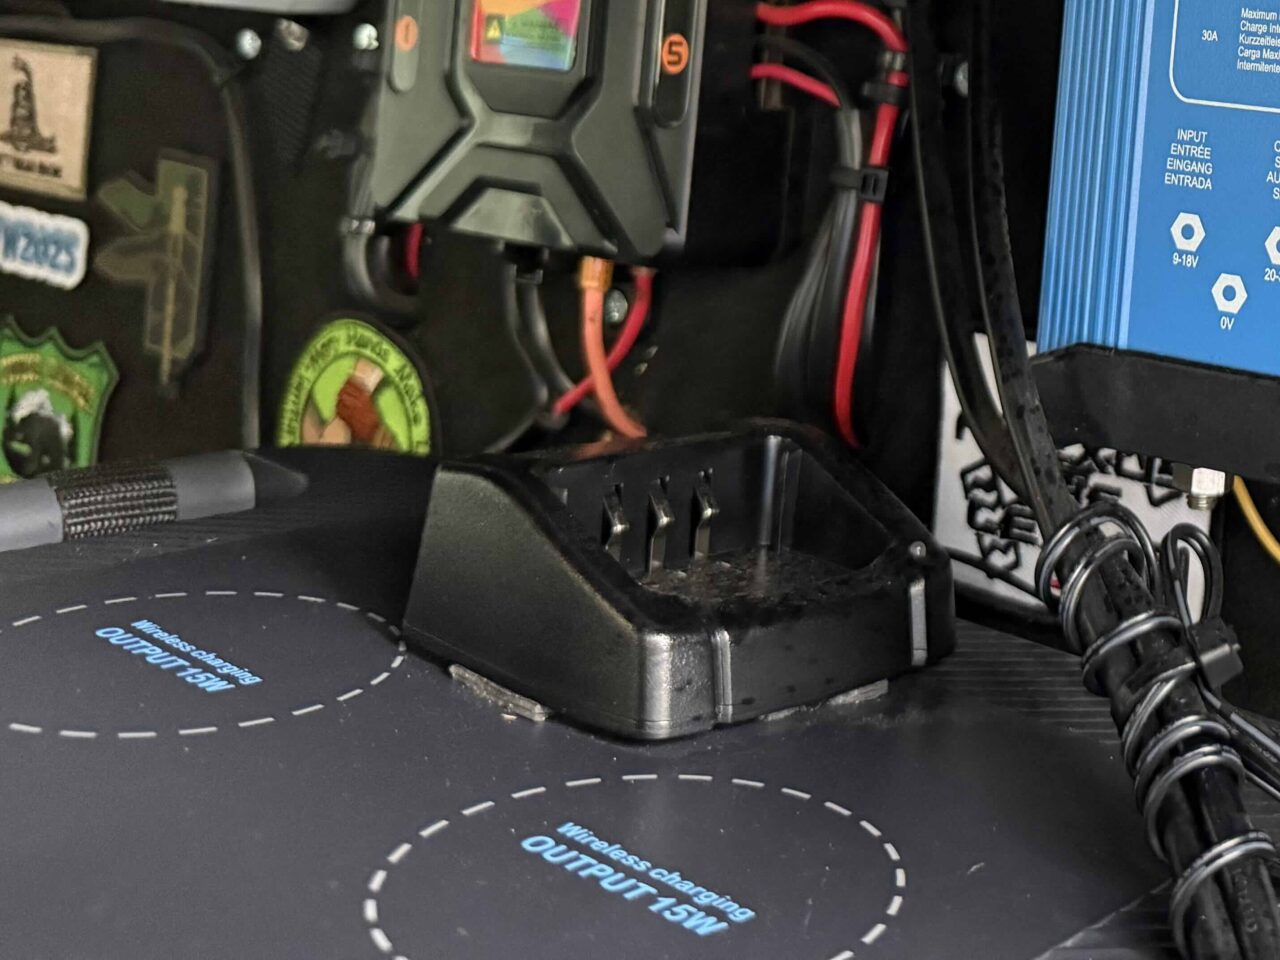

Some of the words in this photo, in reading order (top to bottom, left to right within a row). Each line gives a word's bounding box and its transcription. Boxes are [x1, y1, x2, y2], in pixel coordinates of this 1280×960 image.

[1240, 7, 1278, 20] Maximum
[1201, 29, 1218, 41] 30A
[1240, 20, 1268, 34] Charge
[1237, 45, 1261, 60] Carga
[1236, 58, 1280, 74] Intermitente
[1177, 128, 1208, 143] INPUT
[1170, 143, 1212, 159] ENTRÉE
[1166, 157, 1213, 175] EINGANG
[1164, 172, 1213, 190] ENTRADA
[1172, 252, 1199, 268] 9-18V
[1220, 315, 1235, 331] 0V
[95, 626, 191, 670] OUTPUT
[176, 667, 236, 693] 15W
[131, 619, 197, 653] Wireless
[191, 648, 263, 686] charging
[556, 821, 651, 872] Wireless
[649, 867, 756, 923] charging
[520, 834, 658, 901] OUTPUT
[648, 895, 729, 936] 15W
